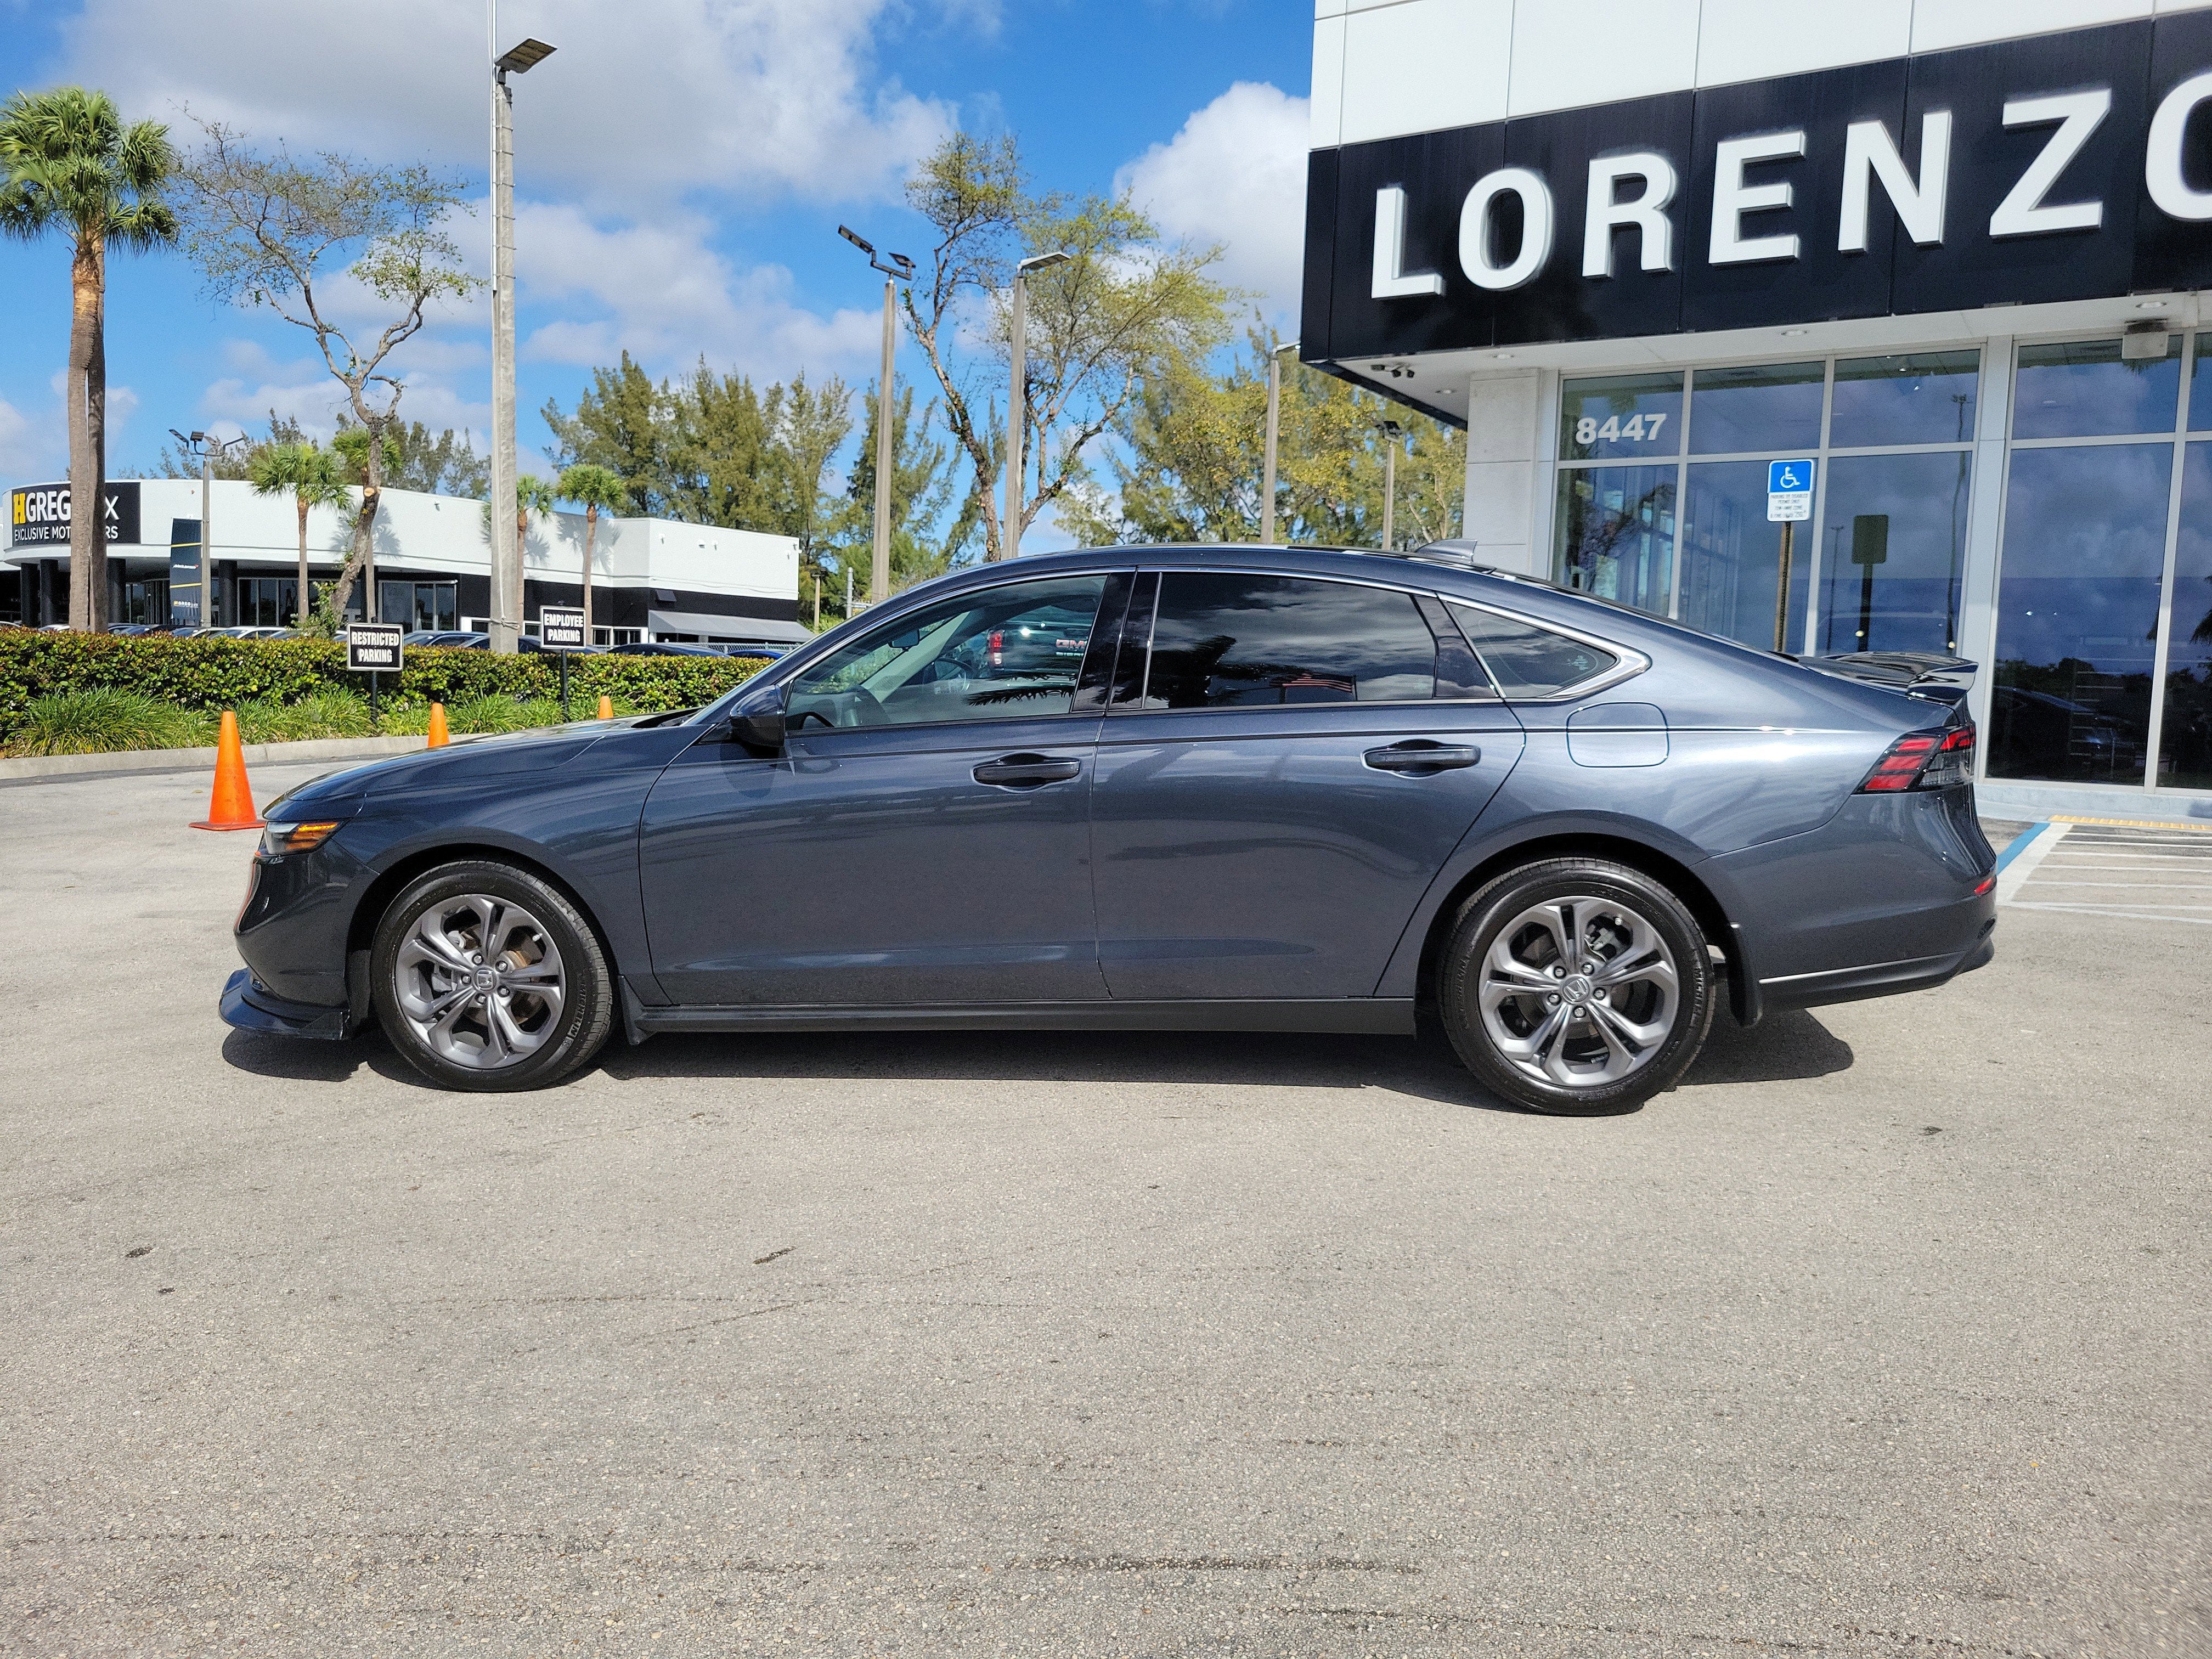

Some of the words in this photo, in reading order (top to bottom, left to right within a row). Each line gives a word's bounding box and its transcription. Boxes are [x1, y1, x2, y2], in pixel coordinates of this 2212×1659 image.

[1372, 72, 2212, 298] LORENZO
[1576, 414, 1666, 444] 8447
[15, 527, 49, 541] EXCLUSIVE
[52, 526, 71, 538] MOT
[544, 613, 583, 628] EMPLOYEE
[351, 631, 399, 646] RESTRICTED
[548, 629, 580, 642] PARKING
[1056, 639, 1087, 648] GM
[358, 648, 392, 663] PARKING
